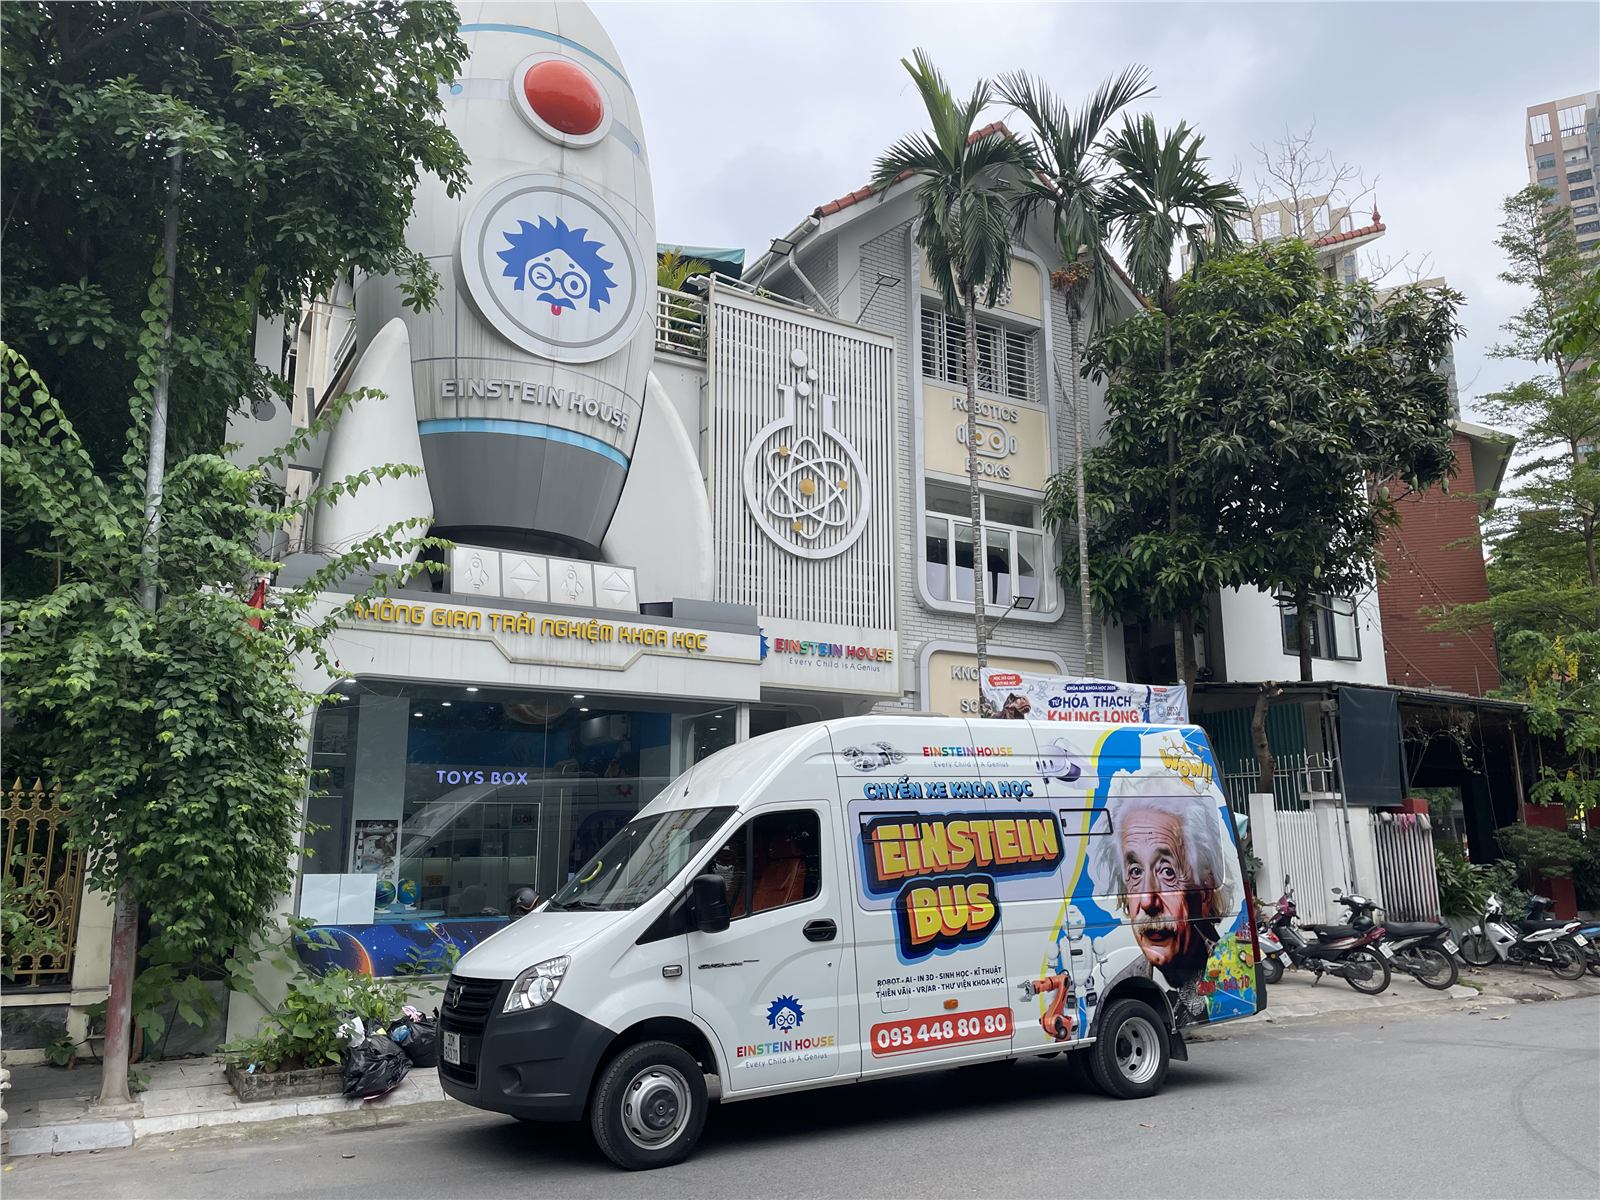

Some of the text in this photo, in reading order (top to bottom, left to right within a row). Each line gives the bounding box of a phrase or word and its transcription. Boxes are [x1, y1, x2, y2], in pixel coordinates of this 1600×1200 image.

[441, 378, 630, 432] EINSTEIN HOUSE
[432, 608, 482, 629] GIAN
[488, 611, 535, 635] TRẢI
[541, 618, 614, 645] NGHIỆM
[618, 626, 668, 647] KHOA
[673, 632, 708, 655] HỌC
[774, 638, 893, 663] EINSTEIN HOUSE
[789, 657, 812, 666] Every
[816, 660, 839, 668] Child
[857, 664, 880, 672] Genius
[1063, 694, 1089, 708] HÓA
[1093, 695, 1131, 710] THẠCH
[1104, 709, 1139, 723] LONG
[922, 746, 1013, 757] EINSTEIN HOUSE
[436, 770, 528, 785] TOYS BOX
[924, 782, 948, 799] XE
[949, 781, 998, 799] KHOA
[998, 780, 1033, 801] HỌC
[872, 818, 1059, 881] EINSTEIN
[906, 883, 995, 945] BUS
[877, 977, 900, 986] ROBOT
[939, 971, 954, 979] SINH
[956, 970, 969, 979] HỌC
[981, 965, 1001, 975] THUẬT
[876, 988, 896, 998] THIÊN
[916, 985, 936, 993] VR/AR
[956, 979, 971, 989] VIỆN
[972, 979, 990, 987] KHOA
[991, 977, 1004, 986] HỌC
[877, 1013, 1007, 1049] 093 448 80 80
[736, 1035, 834, 1058] EINSTEIN HOUSE
[745, 1061, 765, 1069] Every
[768, 1057, 787, 1066] Child
[804, 1053, 828, 1062] Genius
